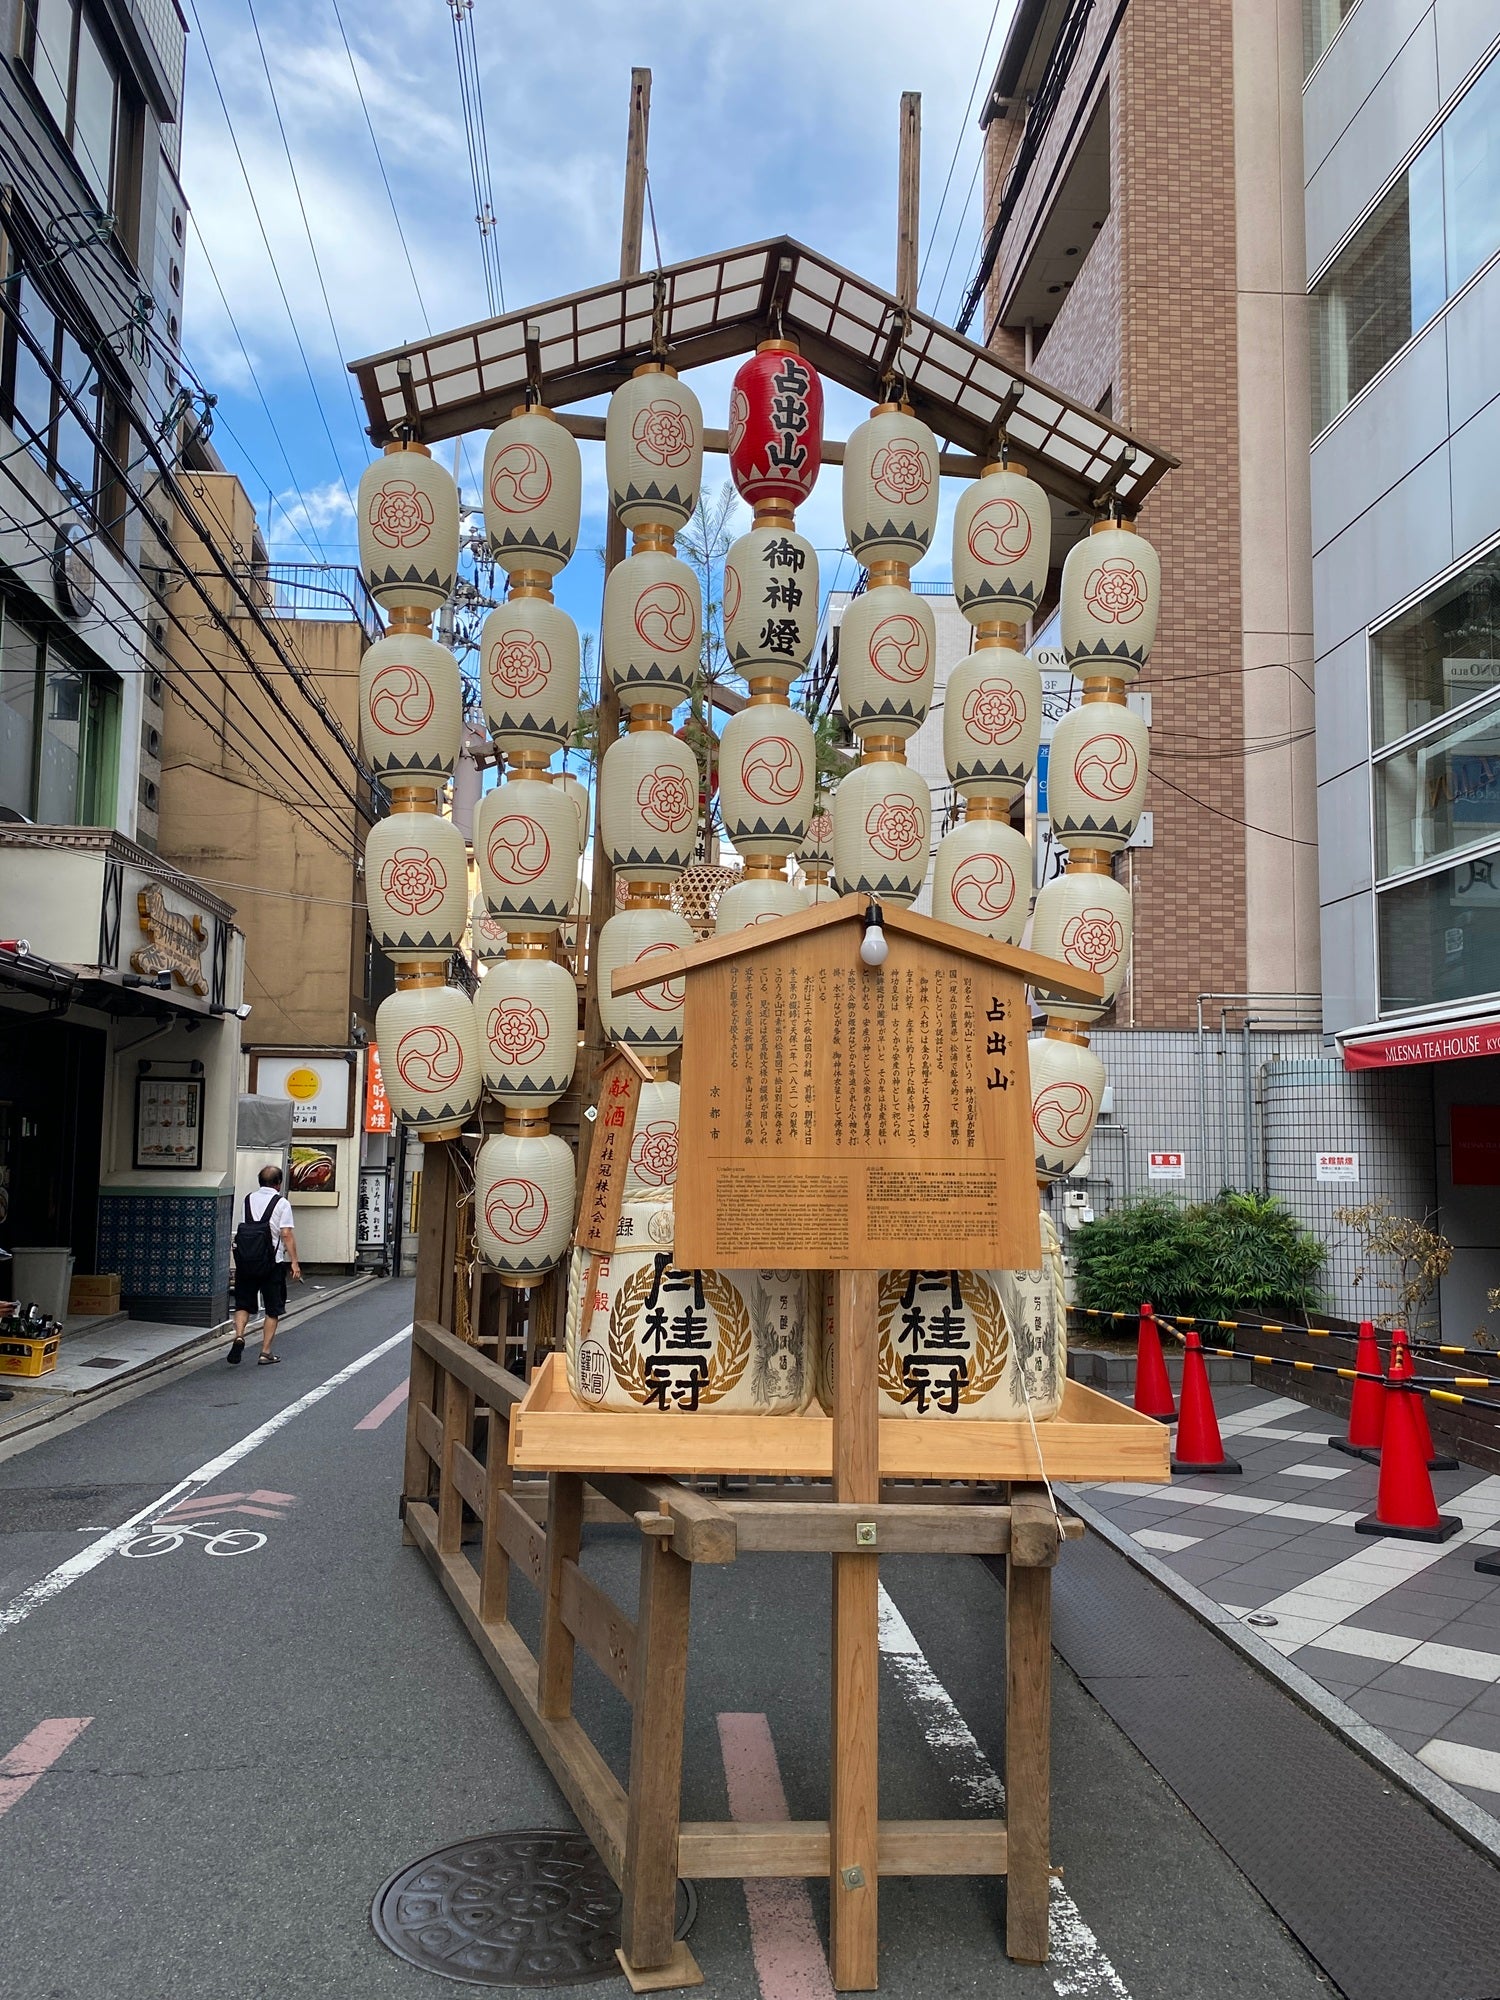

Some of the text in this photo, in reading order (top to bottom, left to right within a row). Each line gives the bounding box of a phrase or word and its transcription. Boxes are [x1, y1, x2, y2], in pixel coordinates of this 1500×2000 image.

[766, 358, 809, 469] 占出山
[759, 537, 806, 657] 御神燈
[1044, 680, 1058, 690] 3F
[986, 997, 1008, 1091] 占出山
[1385, 1043, 1421, 1063] MLESNA
[1443, 1035, 1480, 1056] HOUSE
[604, 1077, 633, 1128] 献酒
[709, 1086, 721, 1141] 京都市
[588, 1132, 615, 1239] 月桂冠株式会社
[1320, 1156, 1354, 1166] 全館禁煙
[643, 1252, 713, 1412] 月桂冠
[898, 1270, 971, 1414] 月桂冠
